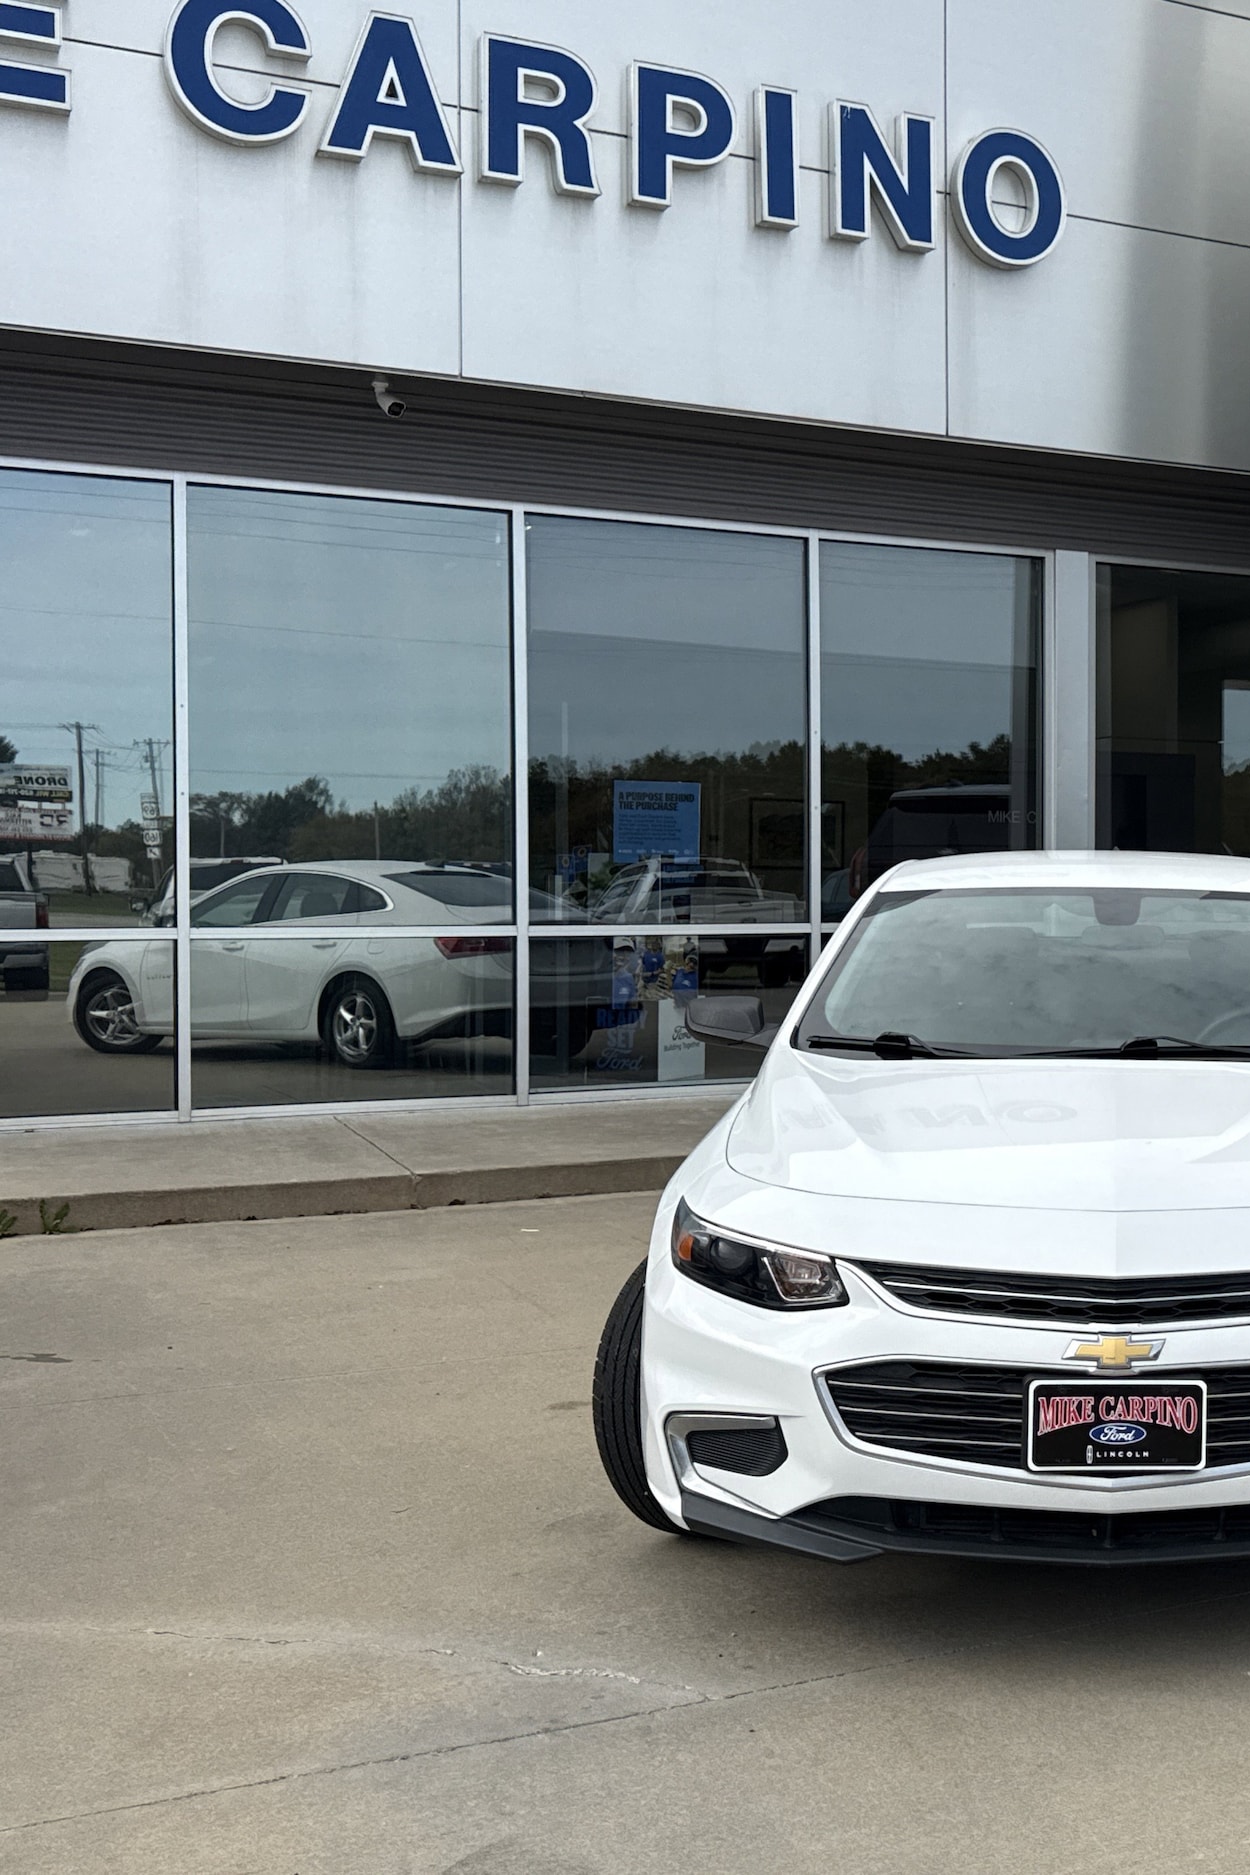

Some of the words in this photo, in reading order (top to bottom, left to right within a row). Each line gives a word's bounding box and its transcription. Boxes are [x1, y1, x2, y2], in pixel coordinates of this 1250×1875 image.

[165, 0, 1067, 270] CARPINO
[618, 792, 624, 801] A
[625, 791, 663, 802] PURPOSE
[664, 792, 695, 803] BEHIND
[618, 801, 635, 810] THE
[636, 801, 679, 812] PURCHASE
[988, 810, 1021, 824] MIKE
[596, 1008, 648, 1029] READY
[606, 1029, 636, 1049] SET
[596, 1048, 644, 1071] Ford
[1037, 1396, 1095, 1436] MIKE
[1098, 1395, 1199, 1435] CARPINO
[1100, 1426, 1136, 1442] Ford
[1095, 1450, 1150, 1459] LINCOLN
